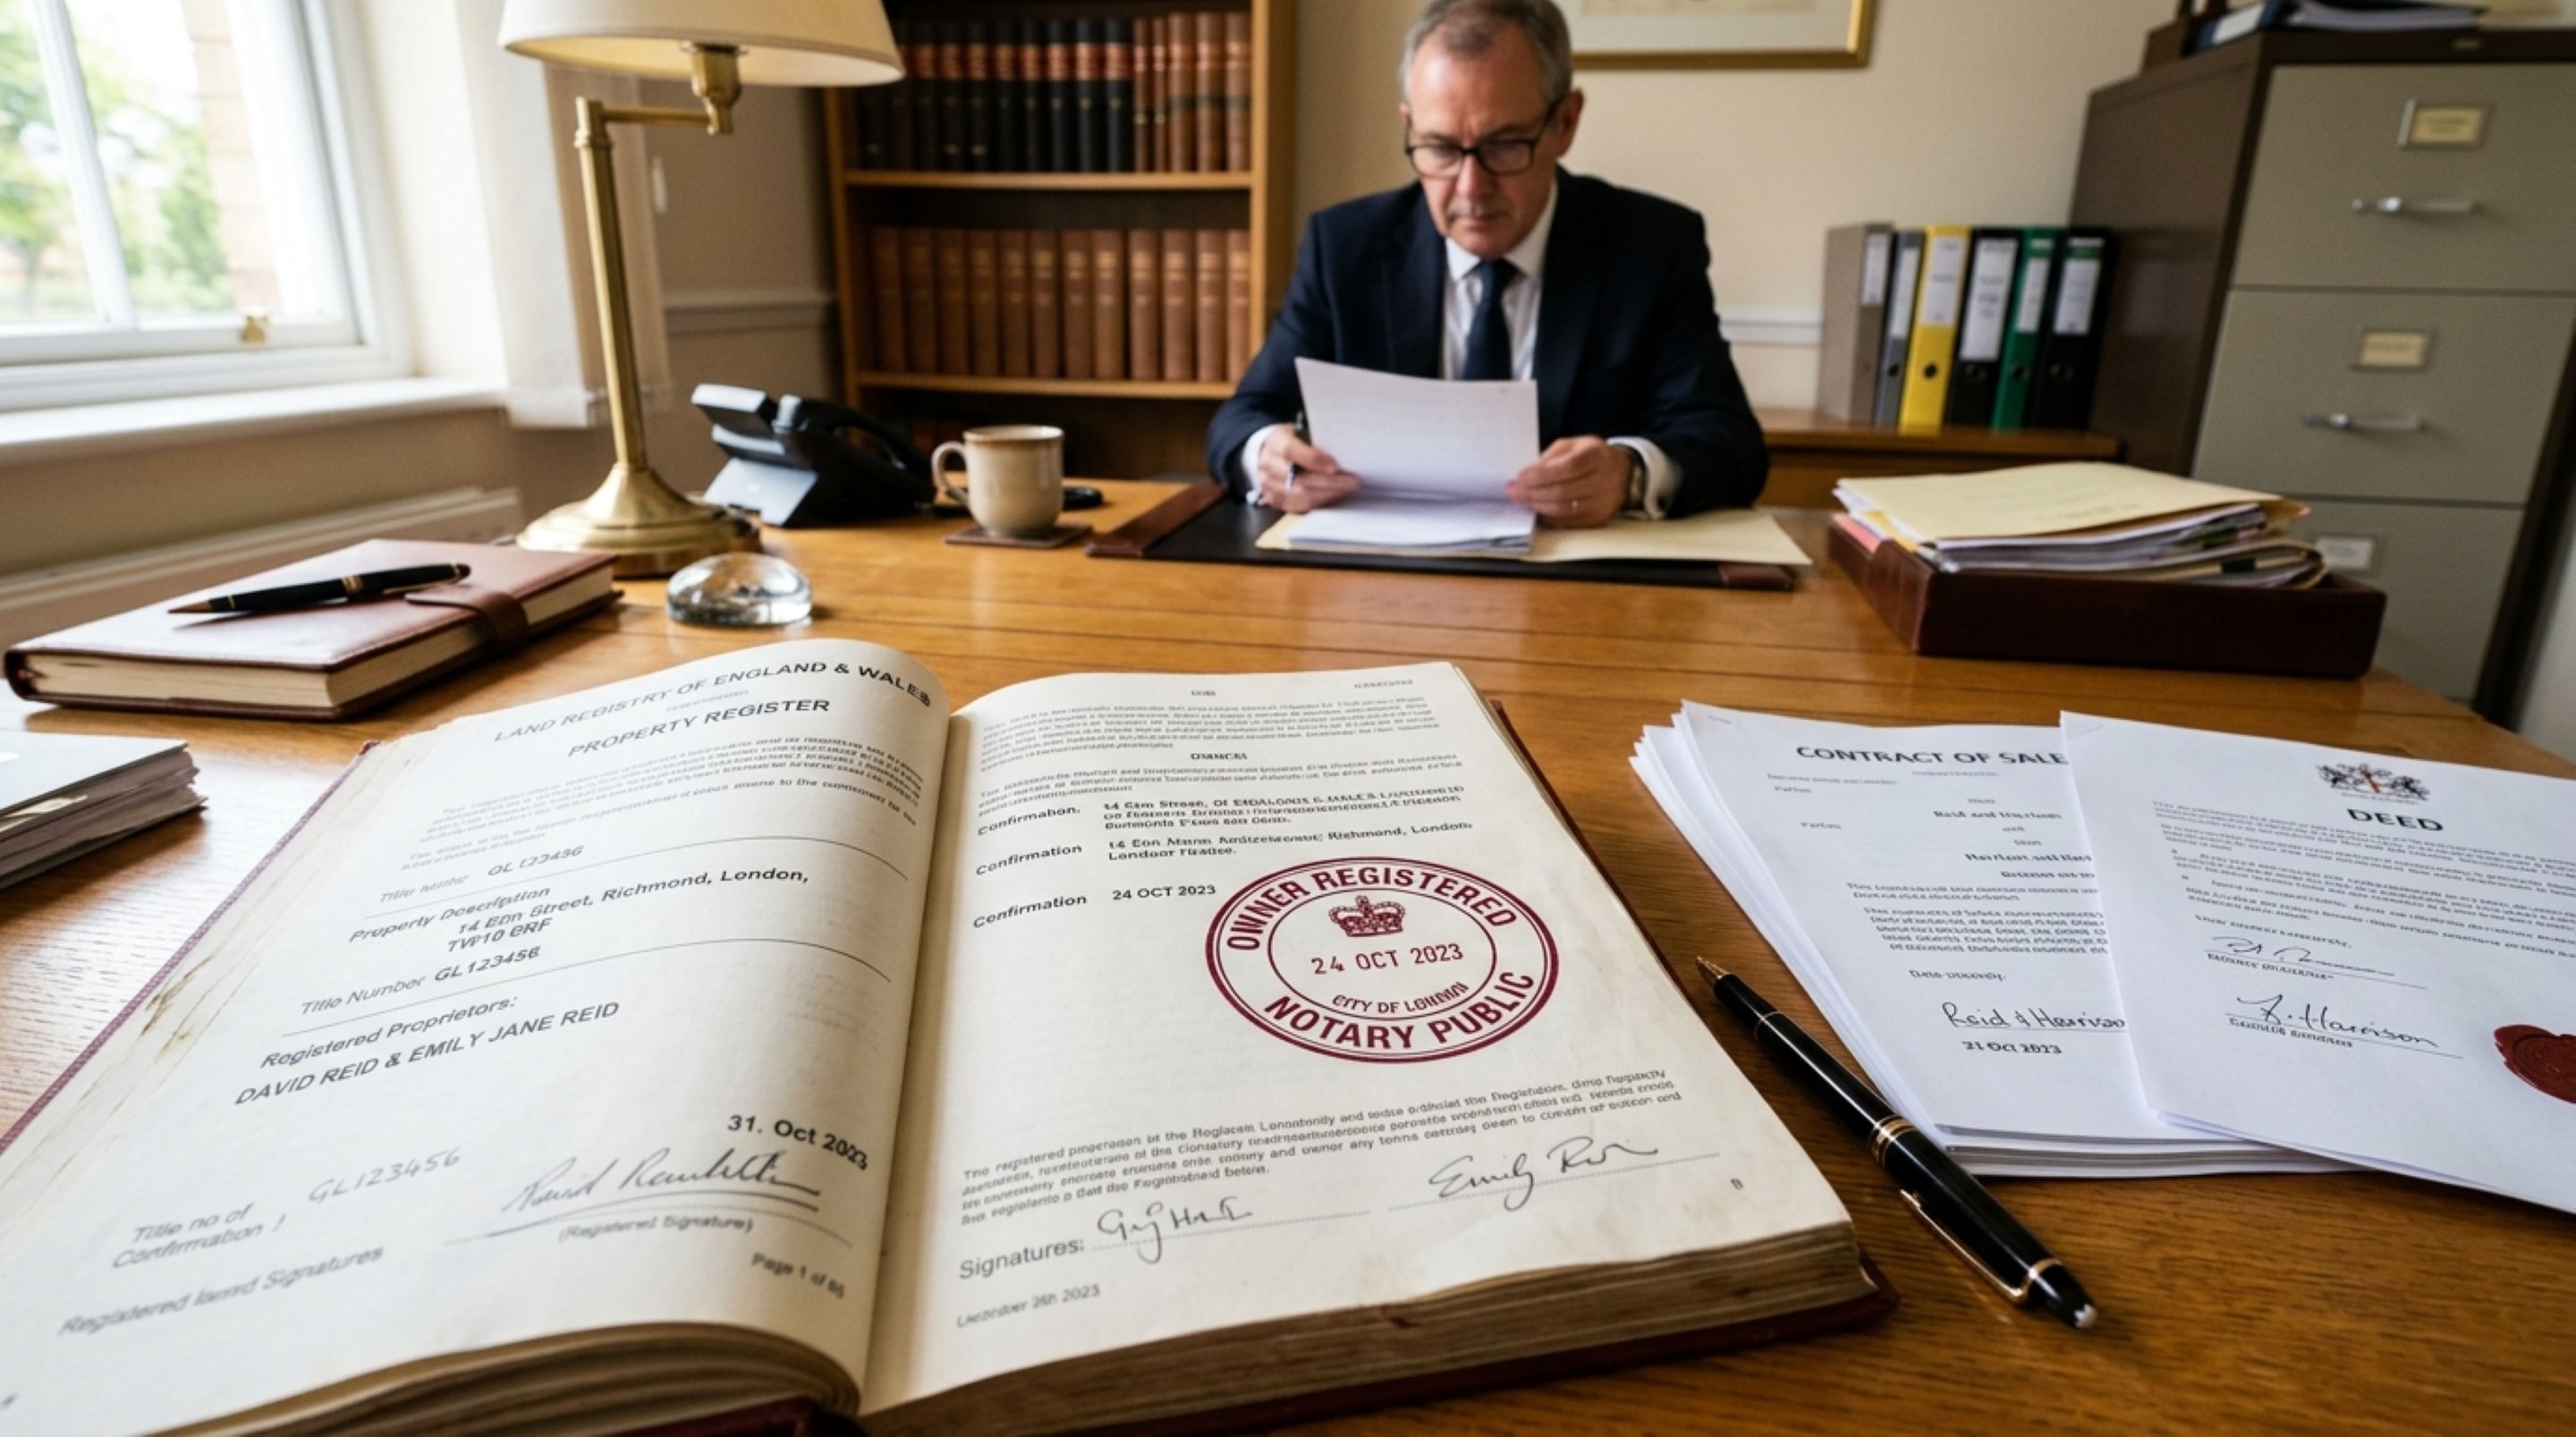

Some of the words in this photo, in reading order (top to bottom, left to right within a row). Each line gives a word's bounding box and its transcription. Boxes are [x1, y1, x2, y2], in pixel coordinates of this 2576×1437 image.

[494, 718, 556, 741] LAND
[676, 678, 708, 695] OF
[714, 661, 826, 686] ENGLAND
[834, 663, 851, 674] &
[568, 714, 699, 757] PROPERTY
[704, 699, 830, 724] REGISTER
[1796, 745, 1945, 764] CONTRACT
[1998, 752, 2071, 766] SALE
[2346, 807, 2444, 833] DEED
[976, 844, 1082, 876] Confirmation
[601, 871, 713, 902] Richmond,
[719, 866, 810, 884] London,
[1112, 889, 1133, 901] 24
[1137, 886, 1174, 899] OCT
[1178, 884, 1217, 897] 2023
[972, 895, 1088, 929] Confirmation
[1226, 879, 1311, 952] OWNER
[1310, 866, 1518, 927] REGISTERED
[1310, 955, 1344, 975] 24
[1355, 949, 1401, 971] OCT
[1410, 943, 1464, 966] 2023
[1264, 995, 1414, 1049] NOTARY
[1426, 971, 1535, 1044] PUBLIC
[259, 1029, 384, 1069] Registered
[386, 995, 520, 1039] Proprietors:
[233, 1073, 316, 1106] DAVID
[319, 1057, 380, 1086] REID
[384, 1052, 403, 1069] &
[407, 1031, 484, 1063] EMILY
[487, 1014, 555, 1044] JANE
[560, 1001, 620, 1027] REID
[727, 1113, 763, 1134] 31.
[773, 1119, 818, 1145] Oct
[188, 1213, 220, 1232] no
[225, 1201, 255, 1223] of
[261, 1245, 386, 1290] Signatures
[959, 1238, 1085, 1281] Signatures:
